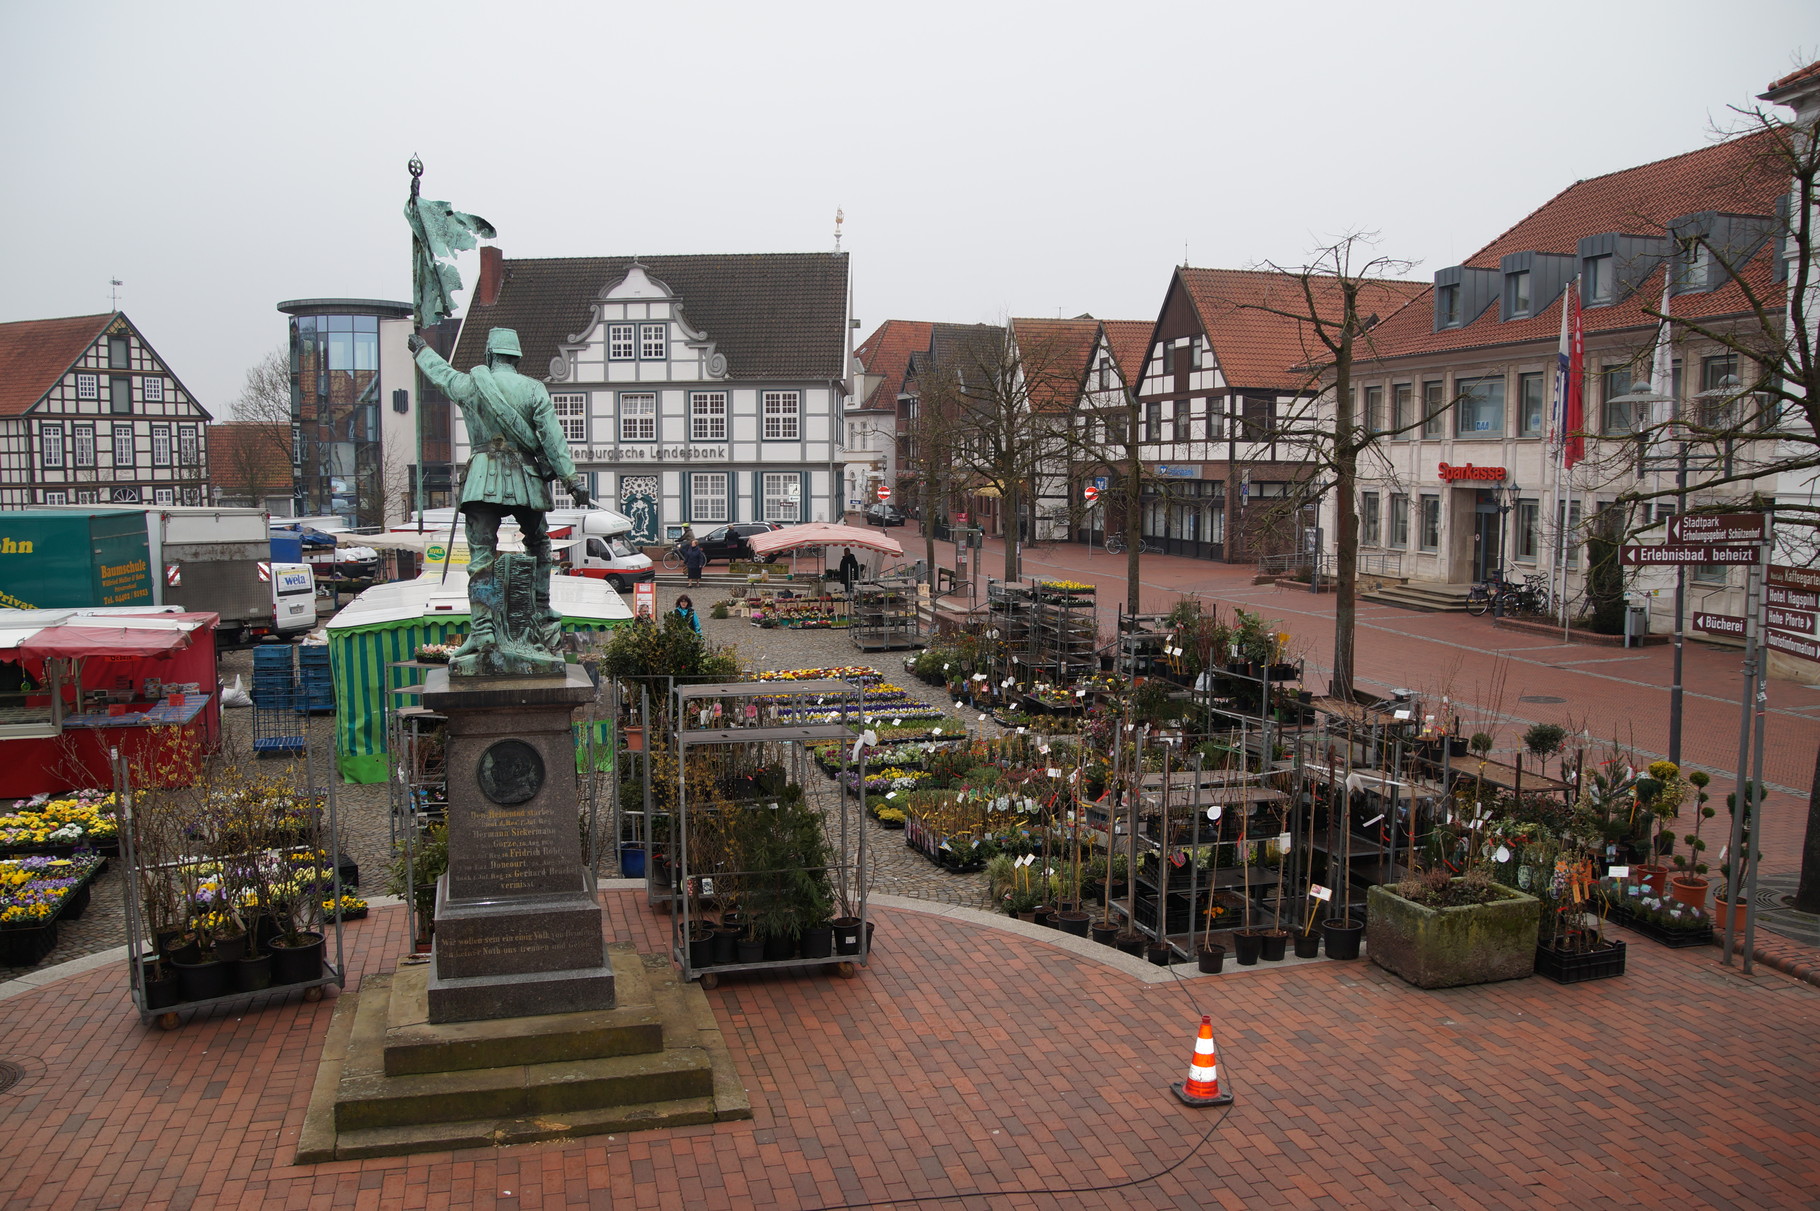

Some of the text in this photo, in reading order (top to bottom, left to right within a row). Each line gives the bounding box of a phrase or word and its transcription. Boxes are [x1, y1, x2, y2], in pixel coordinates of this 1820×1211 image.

[568, 446, 725, 460] denburgische Landesbank
[1438, 462, 1507, 483] Sparkasse
[1683, 516, 1719, 530] Stadtpark
[1683, 527, 1760, 543] Erholungsgebiet Schützenhof
[0, 537, 33, 554] hn
[1640, 548, 1752, 561] Erlebnisbad, beheizt
[101, 560, 146, 578] Baumschule
[103, 595, 114, 605] Tel.
[1769, 589, 1786, 603] Hotel
[1706, 615, 1743, 632] Bücherei
[1768, 610, 1804, 628] Hohe Pforte
[1768, 631, 1815, 657] Touristinformation
[441, 938, 457, 946] Wir
